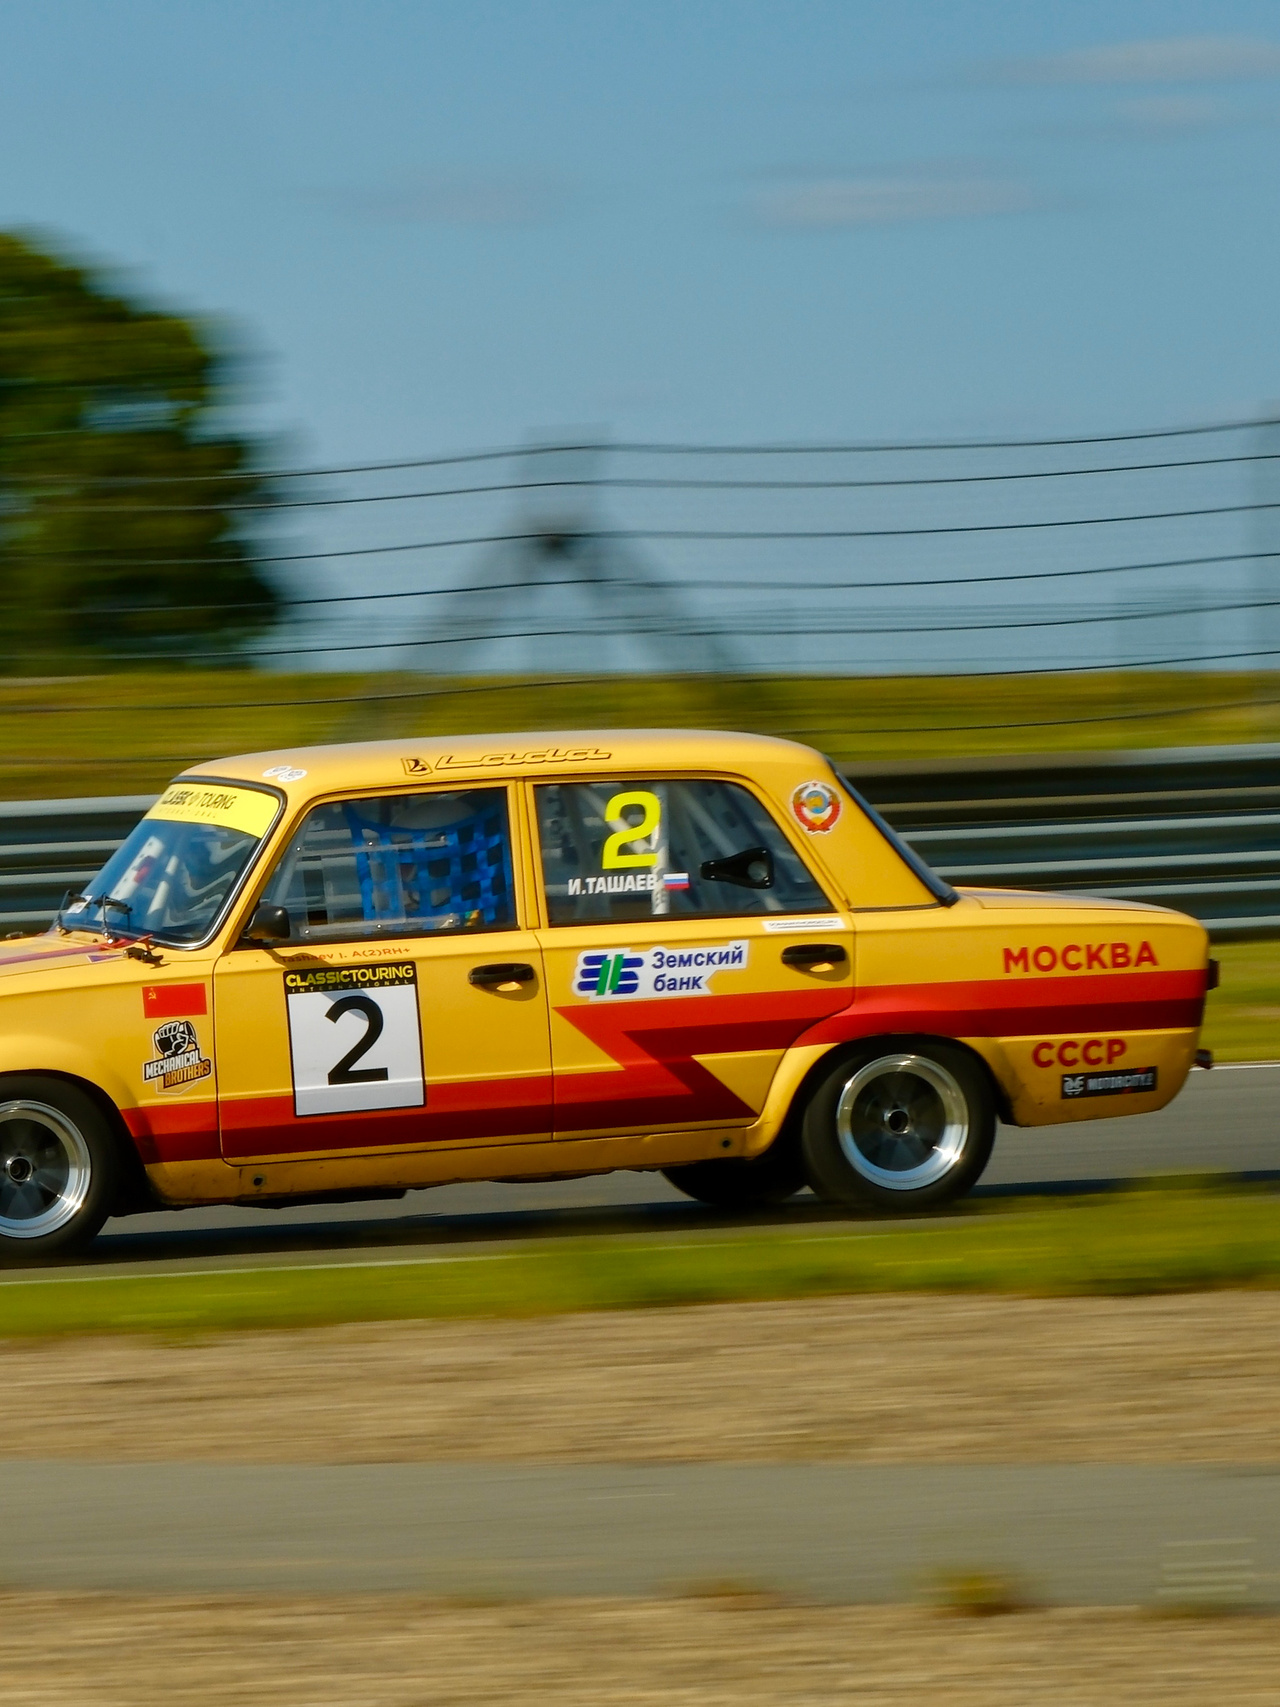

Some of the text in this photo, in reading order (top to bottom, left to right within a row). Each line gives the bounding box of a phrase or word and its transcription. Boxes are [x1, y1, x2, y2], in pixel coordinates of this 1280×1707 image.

[434, 748, 612, 770] Lada
[602, 790, 661, 869] 2
[568, 873, 658, 895] И.ТАШАЕВ
[651, 945, 743, 969] Земский
[1002, 941, 1159, 974] МОСКВА
[653, 973, 704, 992] банк
[324, 995, 389, 1085] 2
[1031, 1039, 1128, 1068] СССР
[145, 1049, 201, 1079] MECHANICAL
[165, 1060, 210, 1086] BROTHERS
